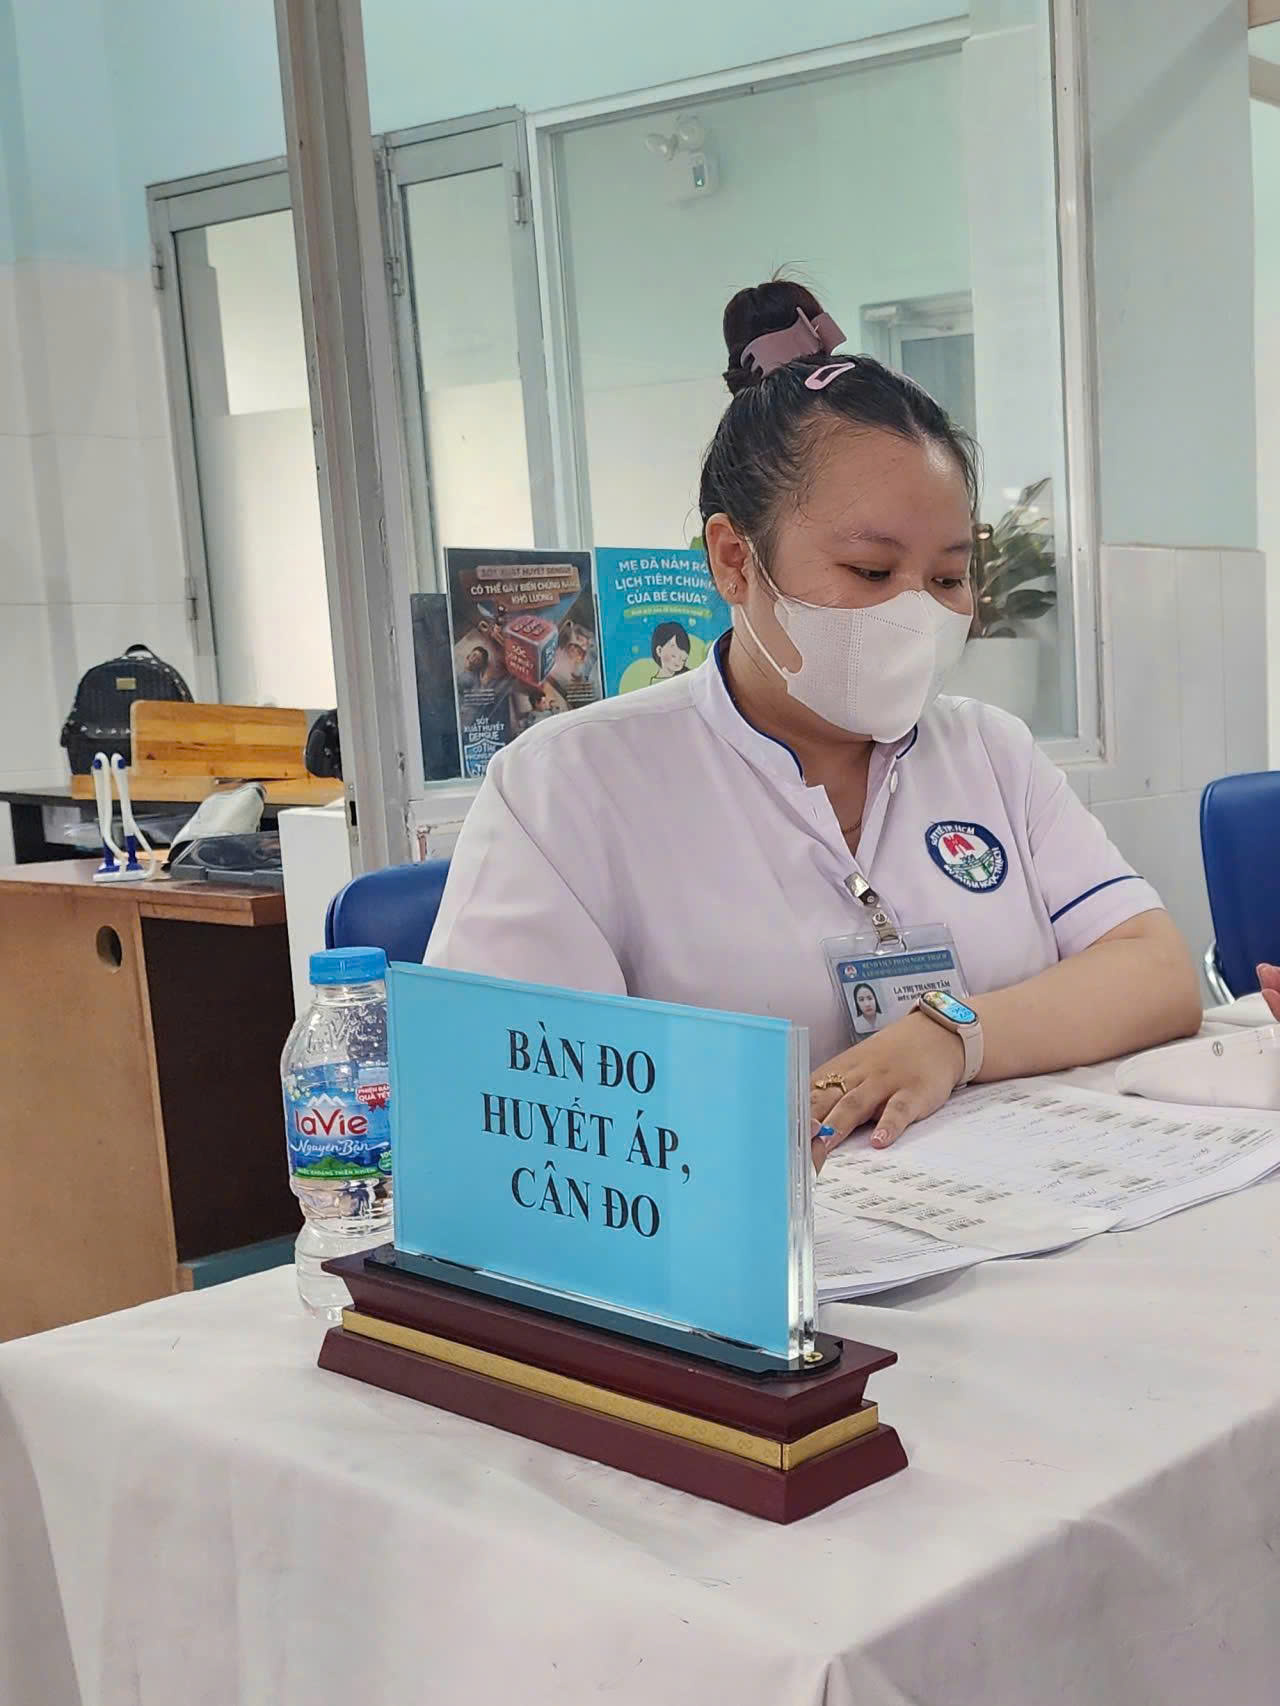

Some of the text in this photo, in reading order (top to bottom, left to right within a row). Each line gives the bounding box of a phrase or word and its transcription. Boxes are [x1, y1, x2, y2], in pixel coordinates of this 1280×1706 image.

[618, 560, 639, 576] MẸ
[640, 556, 660, 570] ĐÃ
[470, 583, 484, 596] CÓ
[615, 575, 643, 592] LỊCH
[645, 572, 673, 586] TIÊM
[627, 589, 651, 605] CỦA
[506, 1021, 656, 1094] BÀN ĐO
[480, 1092, 690, 1184] HUYẾT ÁP,
[511, 1160, 660, 1238] CÂN ĐO
